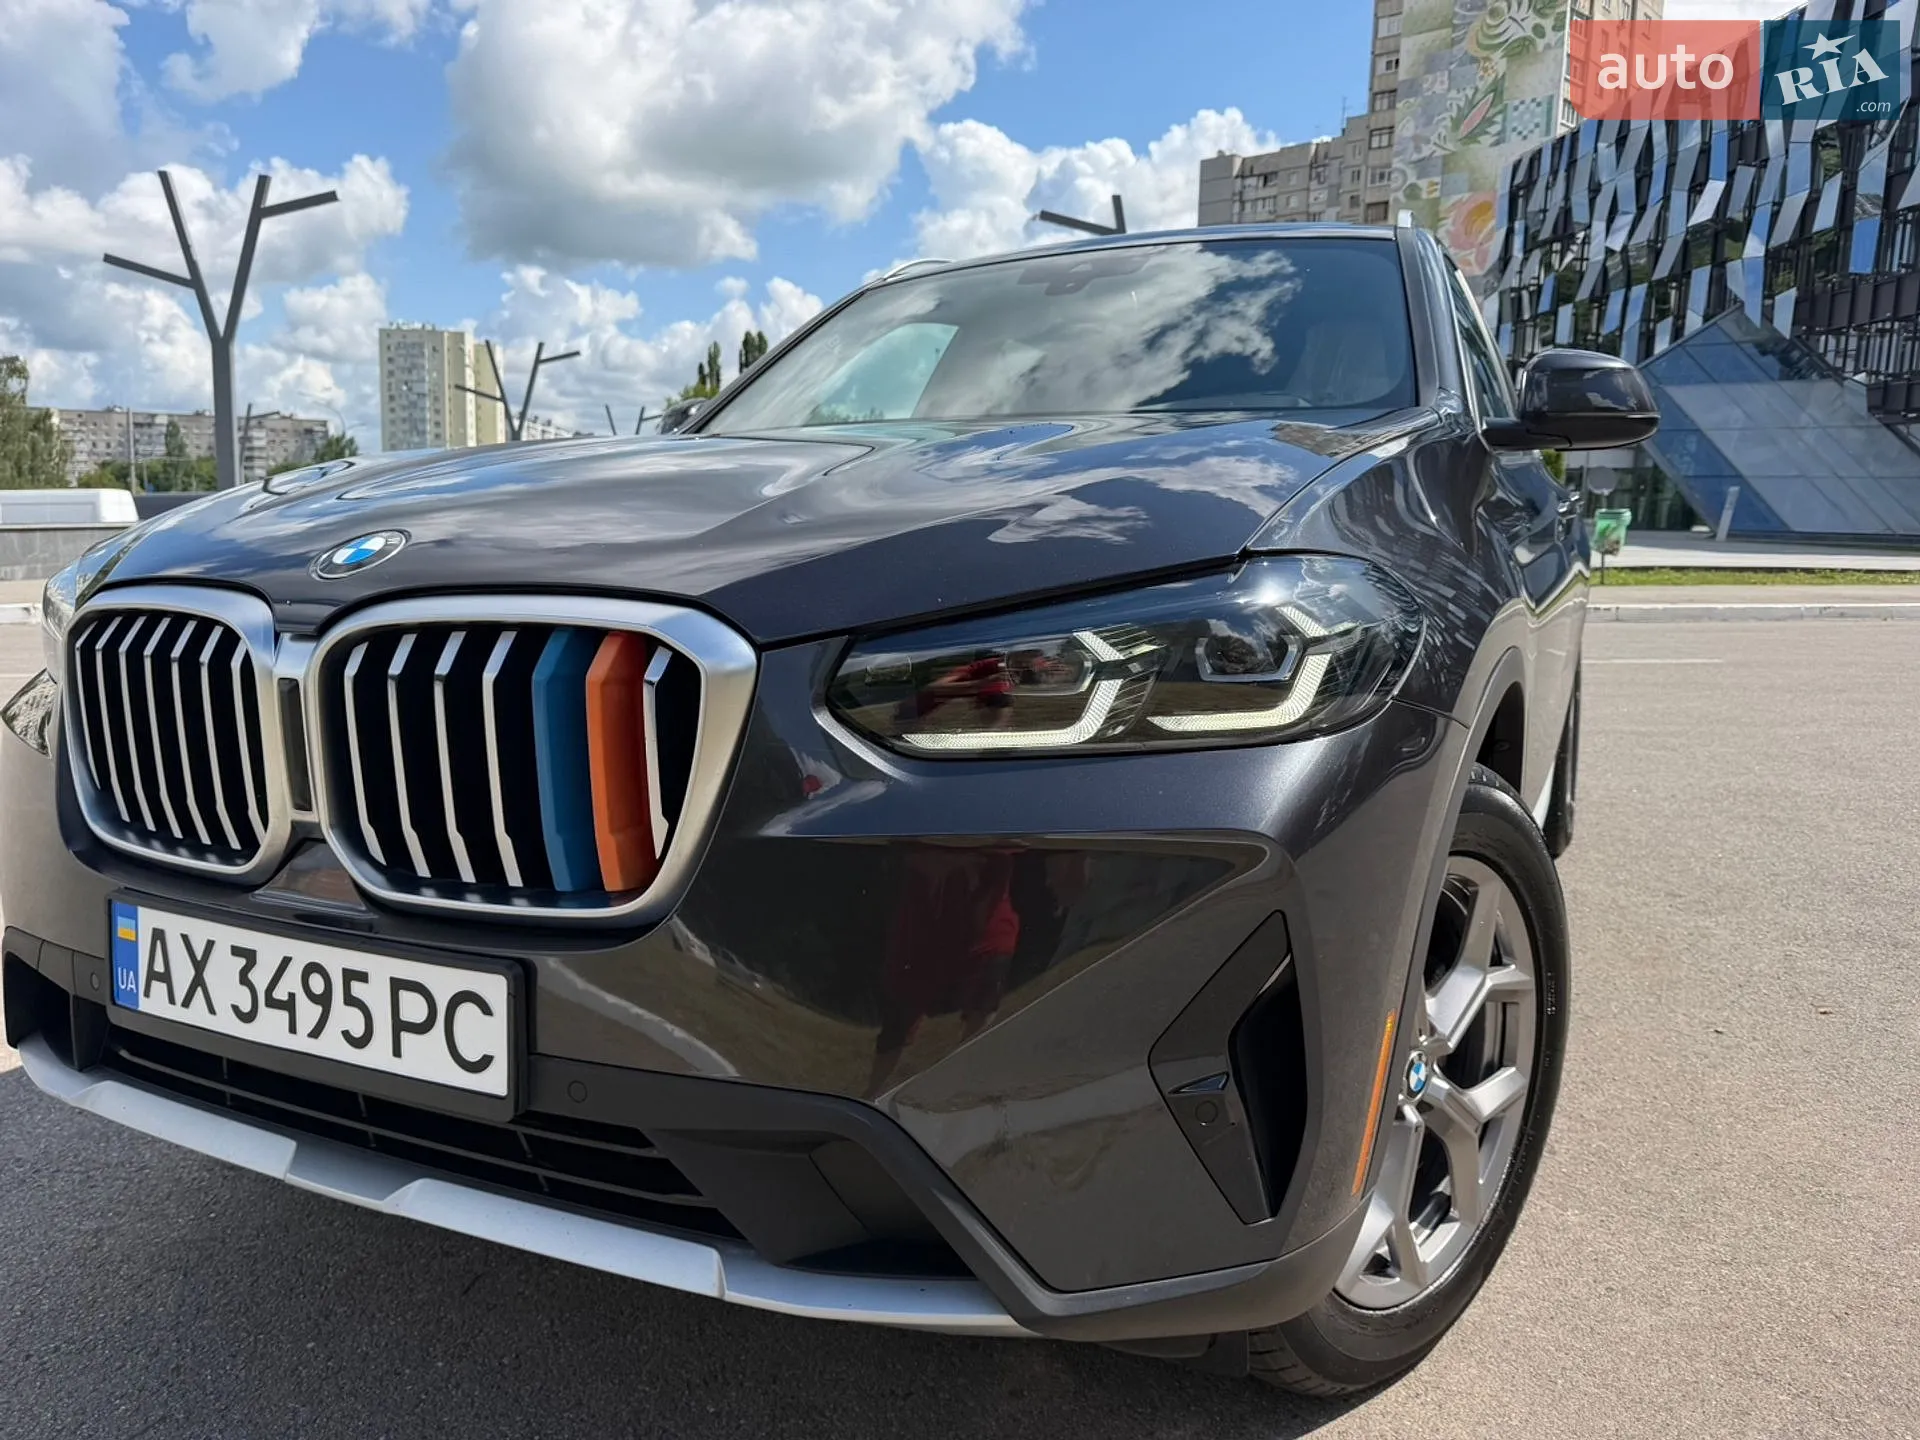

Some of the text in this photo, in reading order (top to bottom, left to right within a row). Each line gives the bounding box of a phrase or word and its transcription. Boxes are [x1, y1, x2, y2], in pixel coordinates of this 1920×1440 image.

[118, 967, 137, 993] UA
[143, 928, 495, 1074] AX 3495 PC
